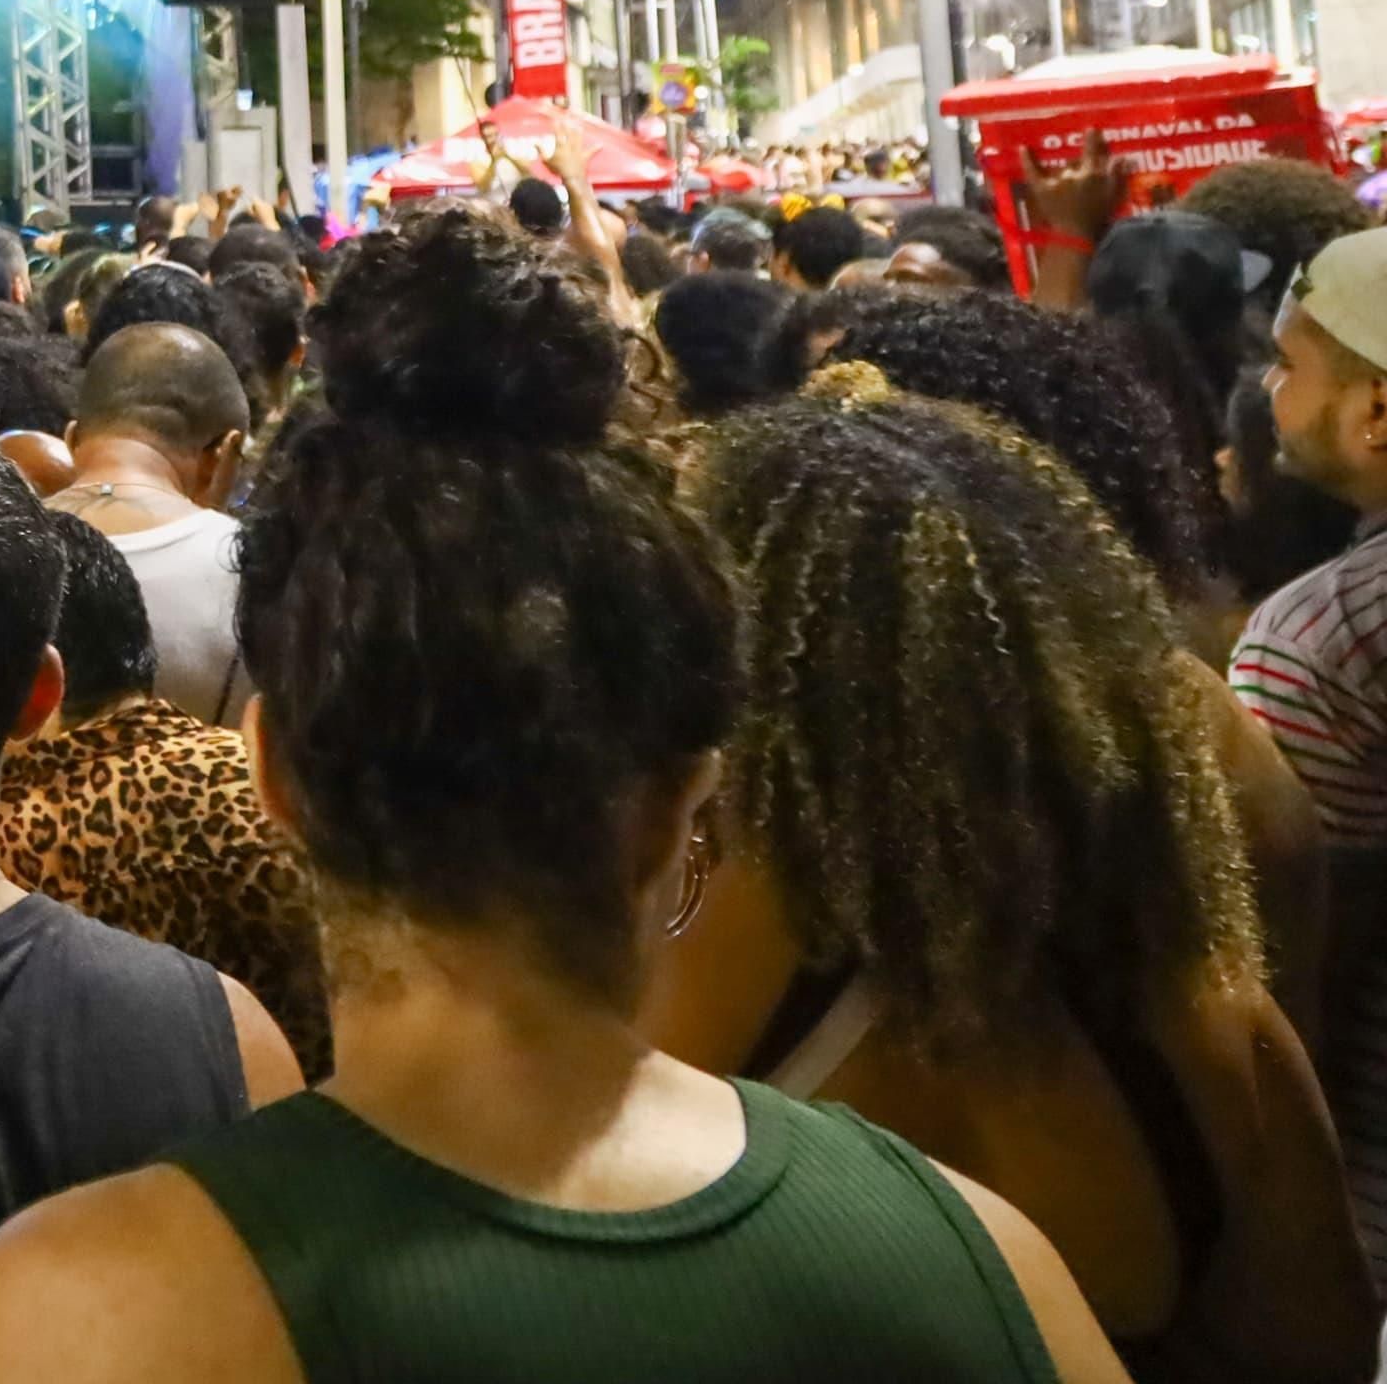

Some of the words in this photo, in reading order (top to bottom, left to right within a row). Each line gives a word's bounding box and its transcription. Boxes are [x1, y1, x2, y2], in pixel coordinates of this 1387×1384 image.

[1042, 134, 1062, 149] O
[1067, 119, 1212, 147] CRNAVAL
[1216, 113, 1256, 130] DA
